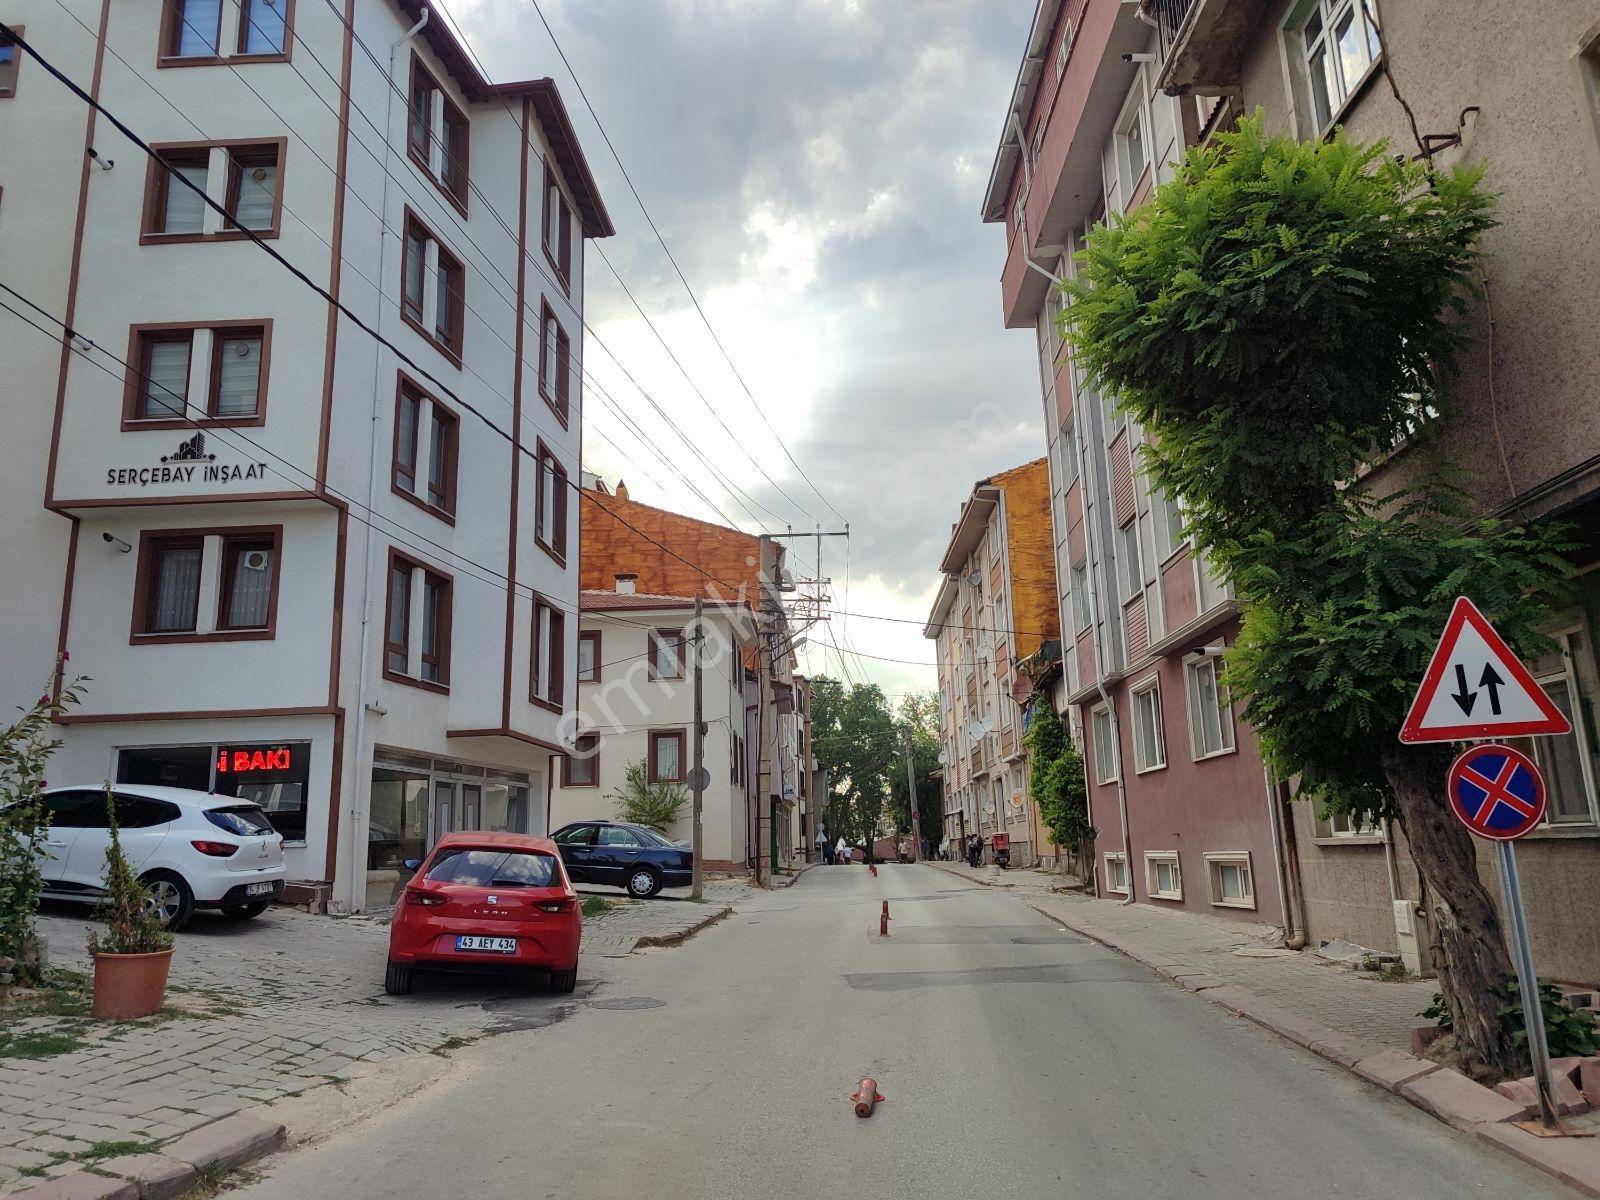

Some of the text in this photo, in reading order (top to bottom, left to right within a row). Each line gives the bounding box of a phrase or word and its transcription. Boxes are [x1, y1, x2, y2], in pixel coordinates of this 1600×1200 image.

[107, 466, 195, 487] SERÇEBAY
[462, 938, 515, 950] 43 AEY 434
